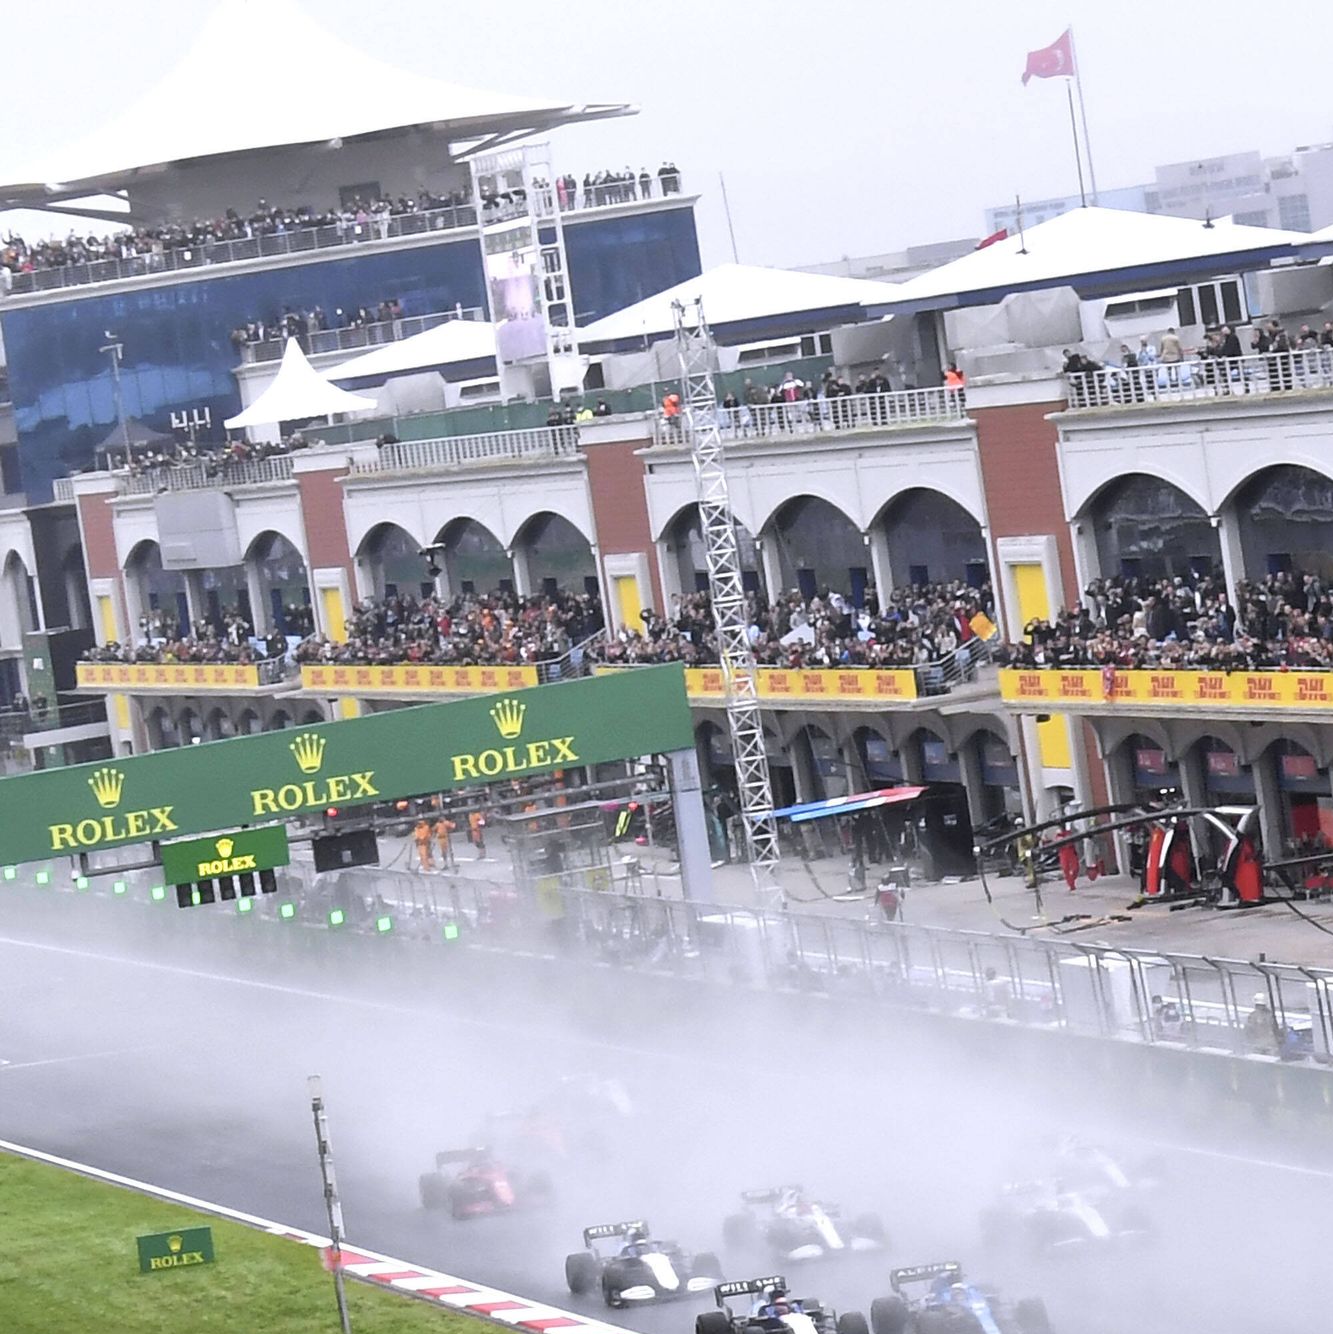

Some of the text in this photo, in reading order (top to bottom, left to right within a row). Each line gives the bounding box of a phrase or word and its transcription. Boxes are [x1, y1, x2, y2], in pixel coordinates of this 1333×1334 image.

[451, 736, 579, 780] ROLEX
[250, 771, 380, 816] ROLEX
[48, 805, 179, 850] ROLEX
[197, 854, 256, 876] ROLEX
[150, 1251, 204, 1269] ROLEX
